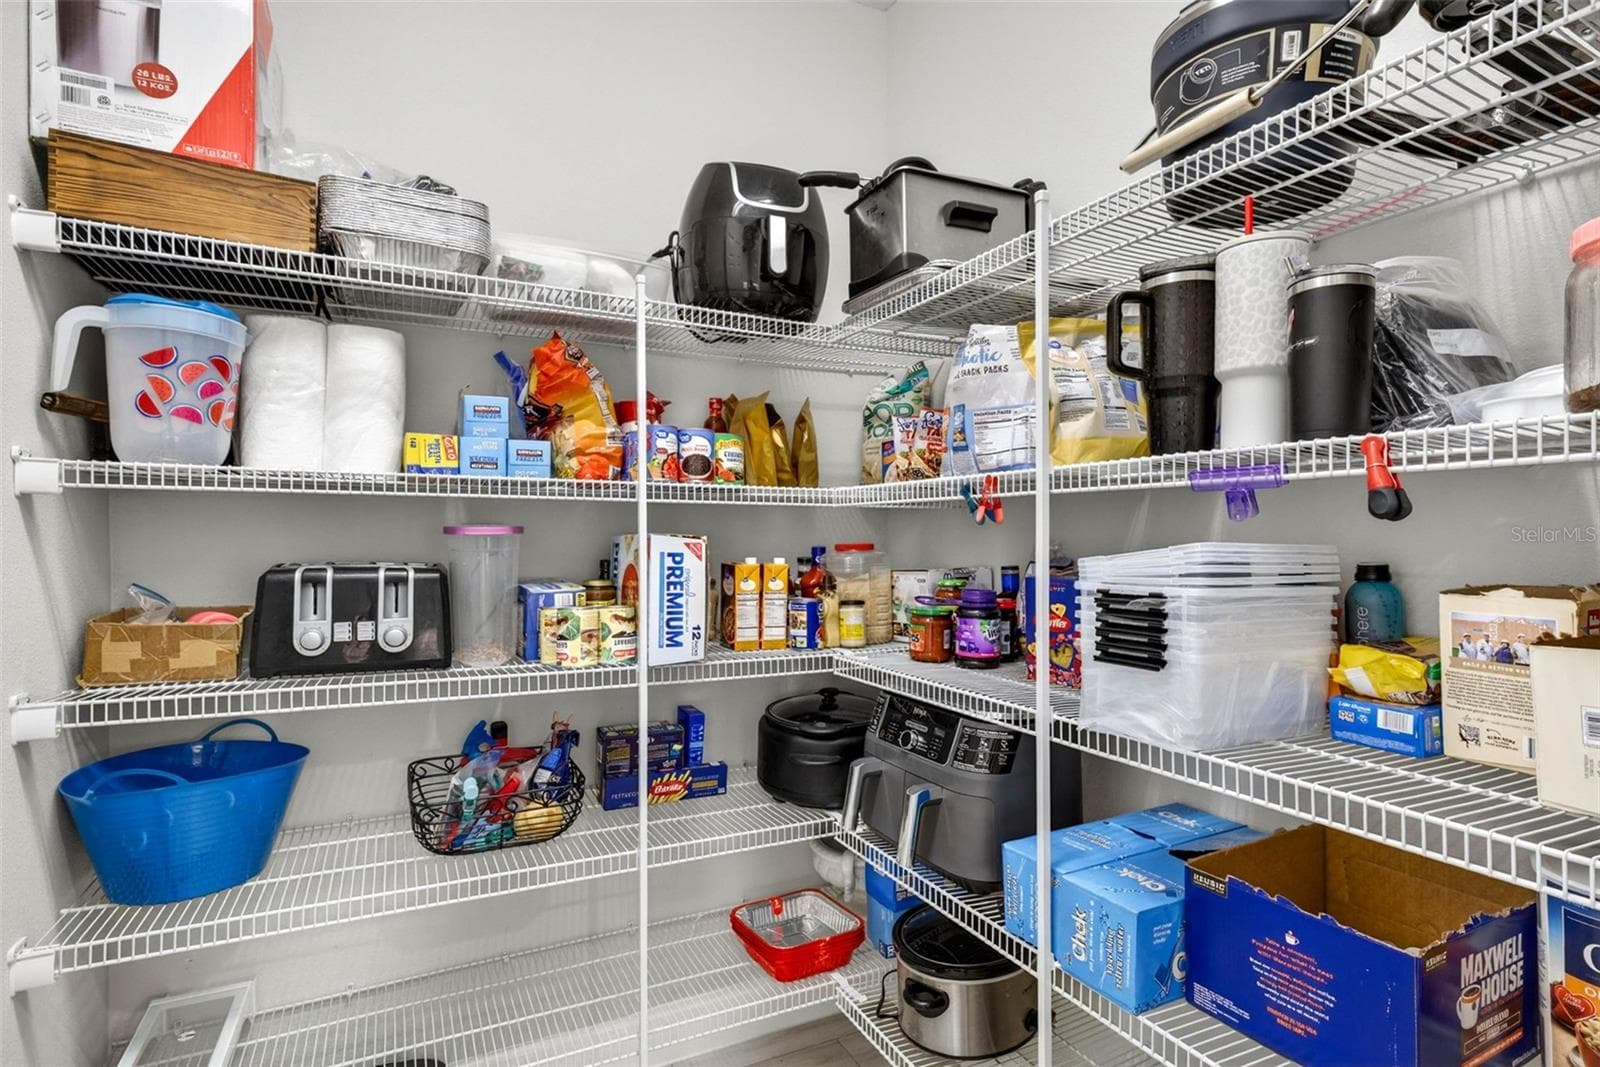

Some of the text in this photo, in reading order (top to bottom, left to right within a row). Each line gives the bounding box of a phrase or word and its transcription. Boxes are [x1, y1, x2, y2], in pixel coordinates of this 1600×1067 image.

[1194, 64, 1212, 76] YETI
[665, 551, 684, 648] PREMIUM
[692, 624, 702, 640] 12
[654, 783, 683, 794] Barilla
[1072, 904, 1087, 962] Chek
[1461, 933, 1524, 988] MAXWELL
[1481, 961, 1524, 1008] HOUSE
